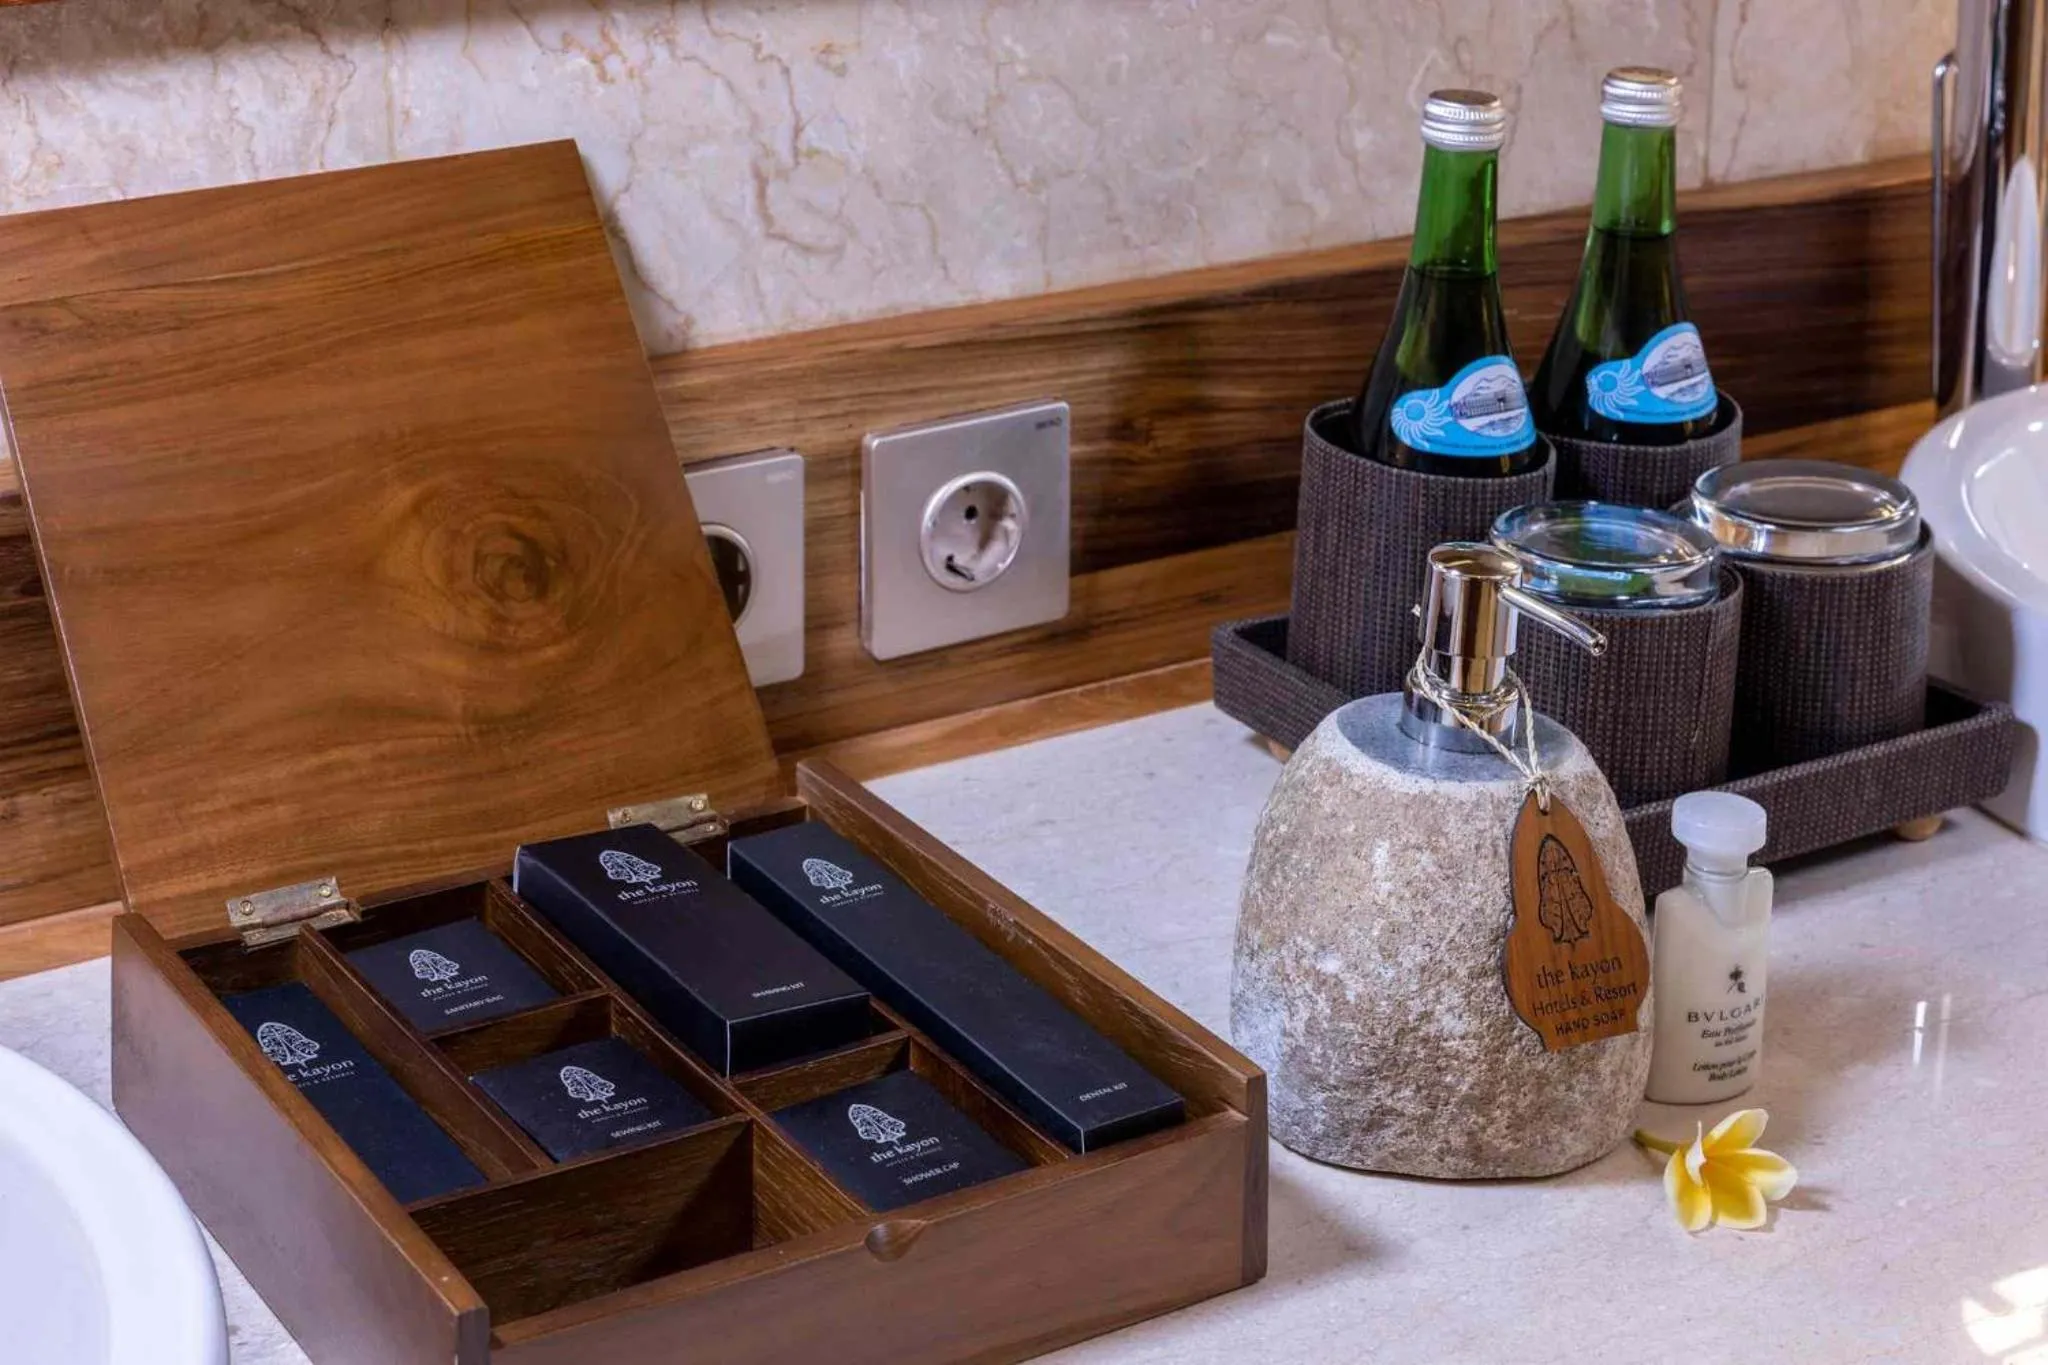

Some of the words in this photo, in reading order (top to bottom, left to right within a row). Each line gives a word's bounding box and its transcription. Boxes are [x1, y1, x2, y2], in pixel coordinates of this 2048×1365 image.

[617, 889, 645, 901] the
[645, 880, 698, 894] kayon
[820, 894, 841, 905] the
[841, 883, 883, 898] kayon
[1536, 964, 1565, 989] the
[1567, 956, 1622, 985] kayon
[420, 987, 443, 999] the
[443, 975, 489, 990] kayon
[1532, 993, 1578, 1017] Hotels
[1580, 988, 1593, 1007] &
[1593, 981, 1638, 1003] Resort
[1555, 1017, 1590, 1036] HAND
[1592, 1008, 1625, 1027] SOAP
[298, 1059, 355, 1077] kayon
[1080, 1087, 1112, 1102] DENTAL
[1112, 1082, 1128, 1092] KIT
[578, 1107, 601, 1119] the
[601, 1097, 648, 1111] kayon
[870, 1150, 895, 1163] the
[893, 1136, 940, 1154] kayon
[902, 1167, 943, 1186] SHOWER
